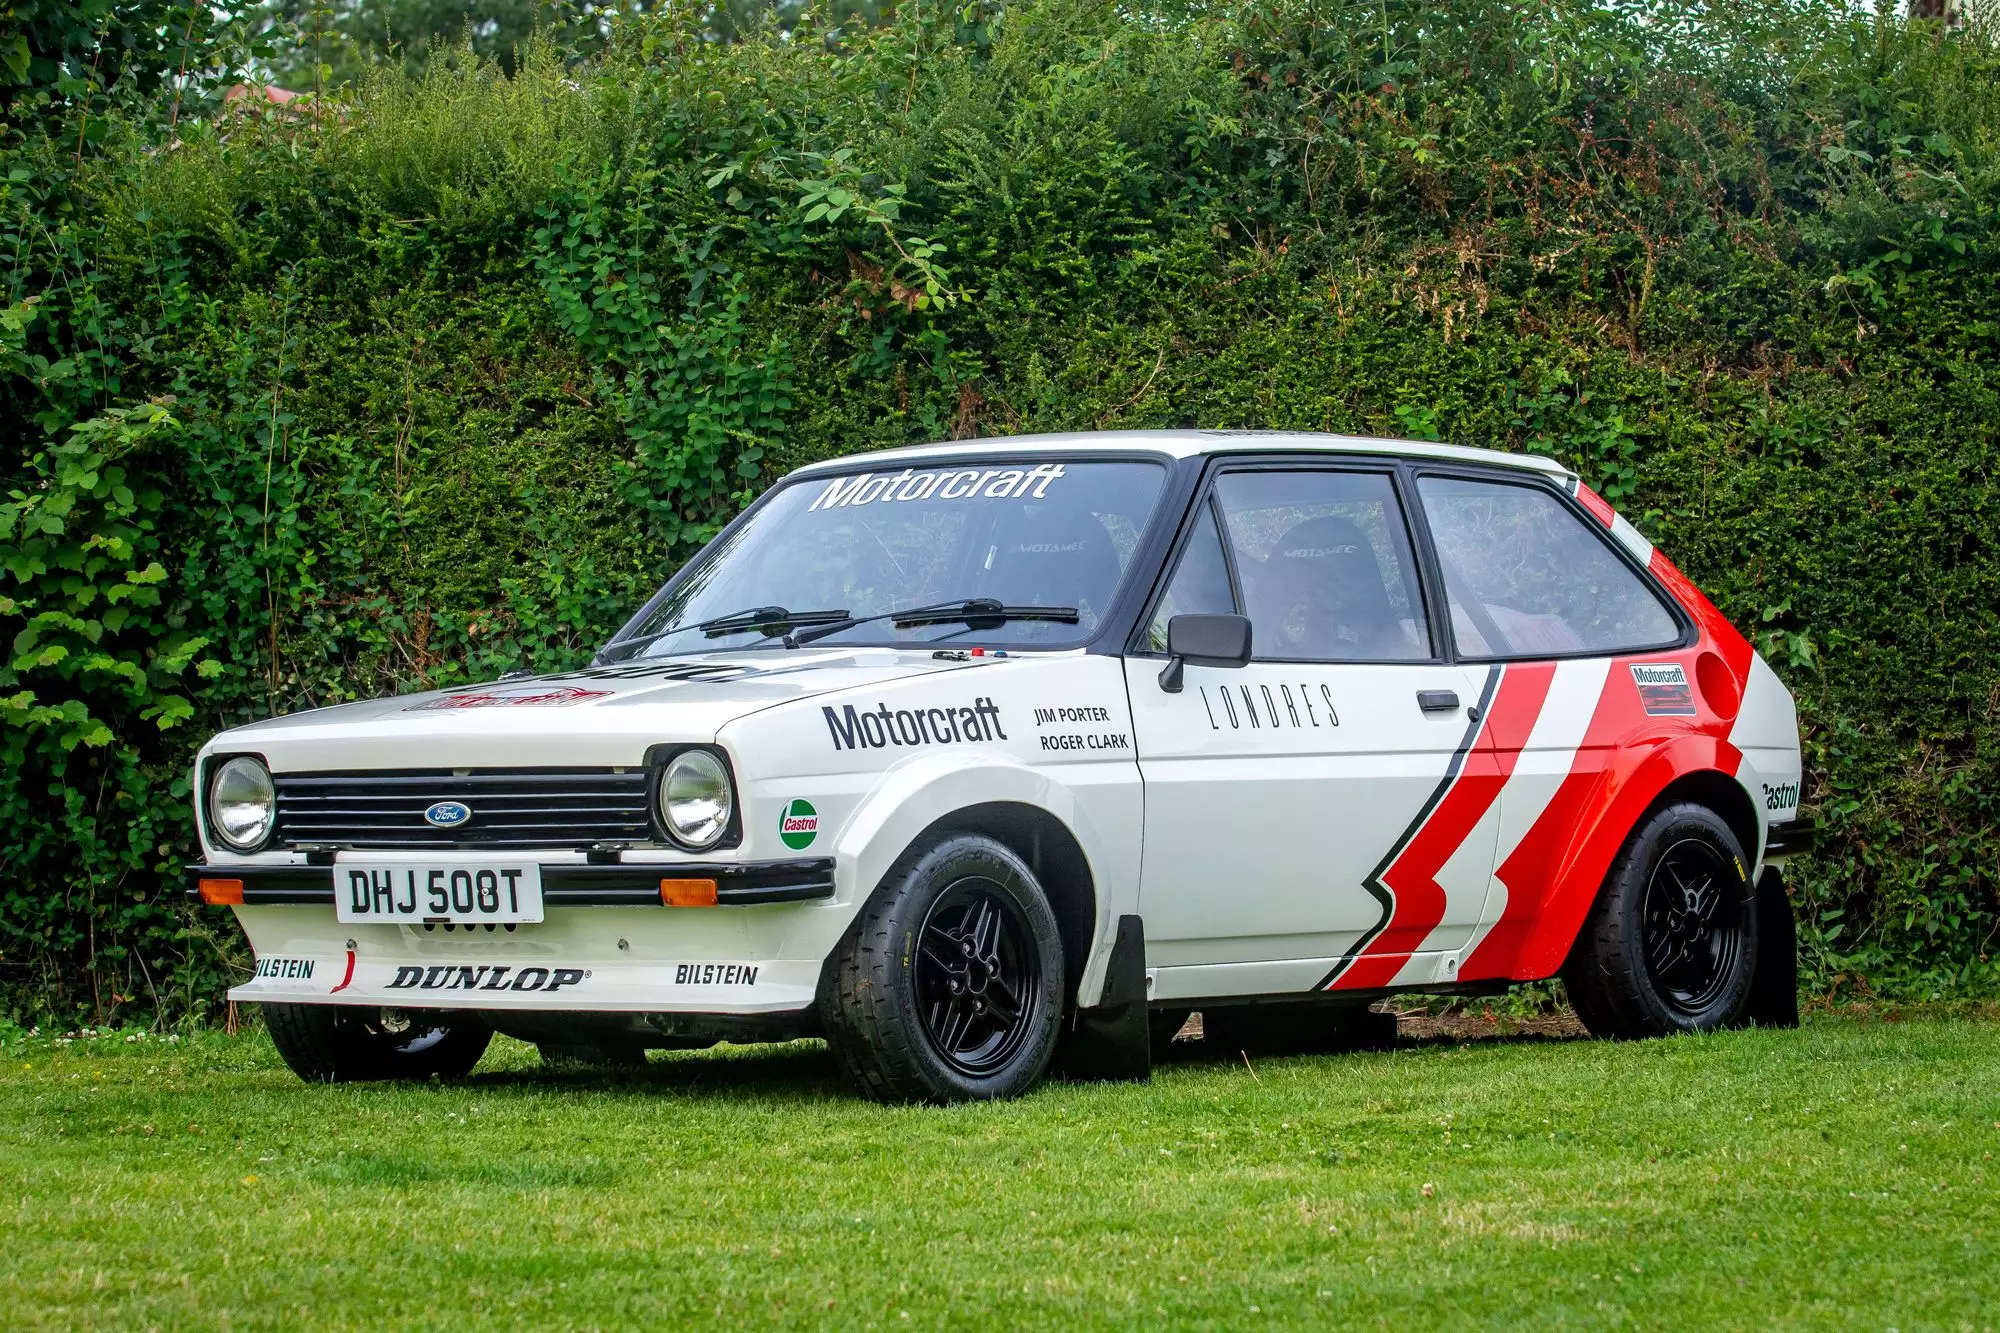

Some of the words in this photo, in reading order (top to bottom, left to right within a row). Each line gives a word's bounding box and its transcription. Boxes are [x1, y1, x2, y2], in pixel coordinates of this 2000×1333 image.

[808, 464, 1066, 513] Motorcraft
[1633, 667, 1685, 683] Motorcraft
[1034, 707, 1057, 726] JIM
[1059, 707, 1110, 723] PORTER
[1200, 684, 1340, 730] LONDRES
[822, 697, 1008, 751] Motorcraft
[1040, 734, 1085, 751] ROGER
[1087, 733, 1130, 750] CLARK
[434, 806, 460, 821] Ford
[784, 818, 818, 831] Castrol
[348, 870, 417, 914] DHJ
[428, 869, 523, 914] 508T
[675, 964, 758, 986] BILSTEIN
